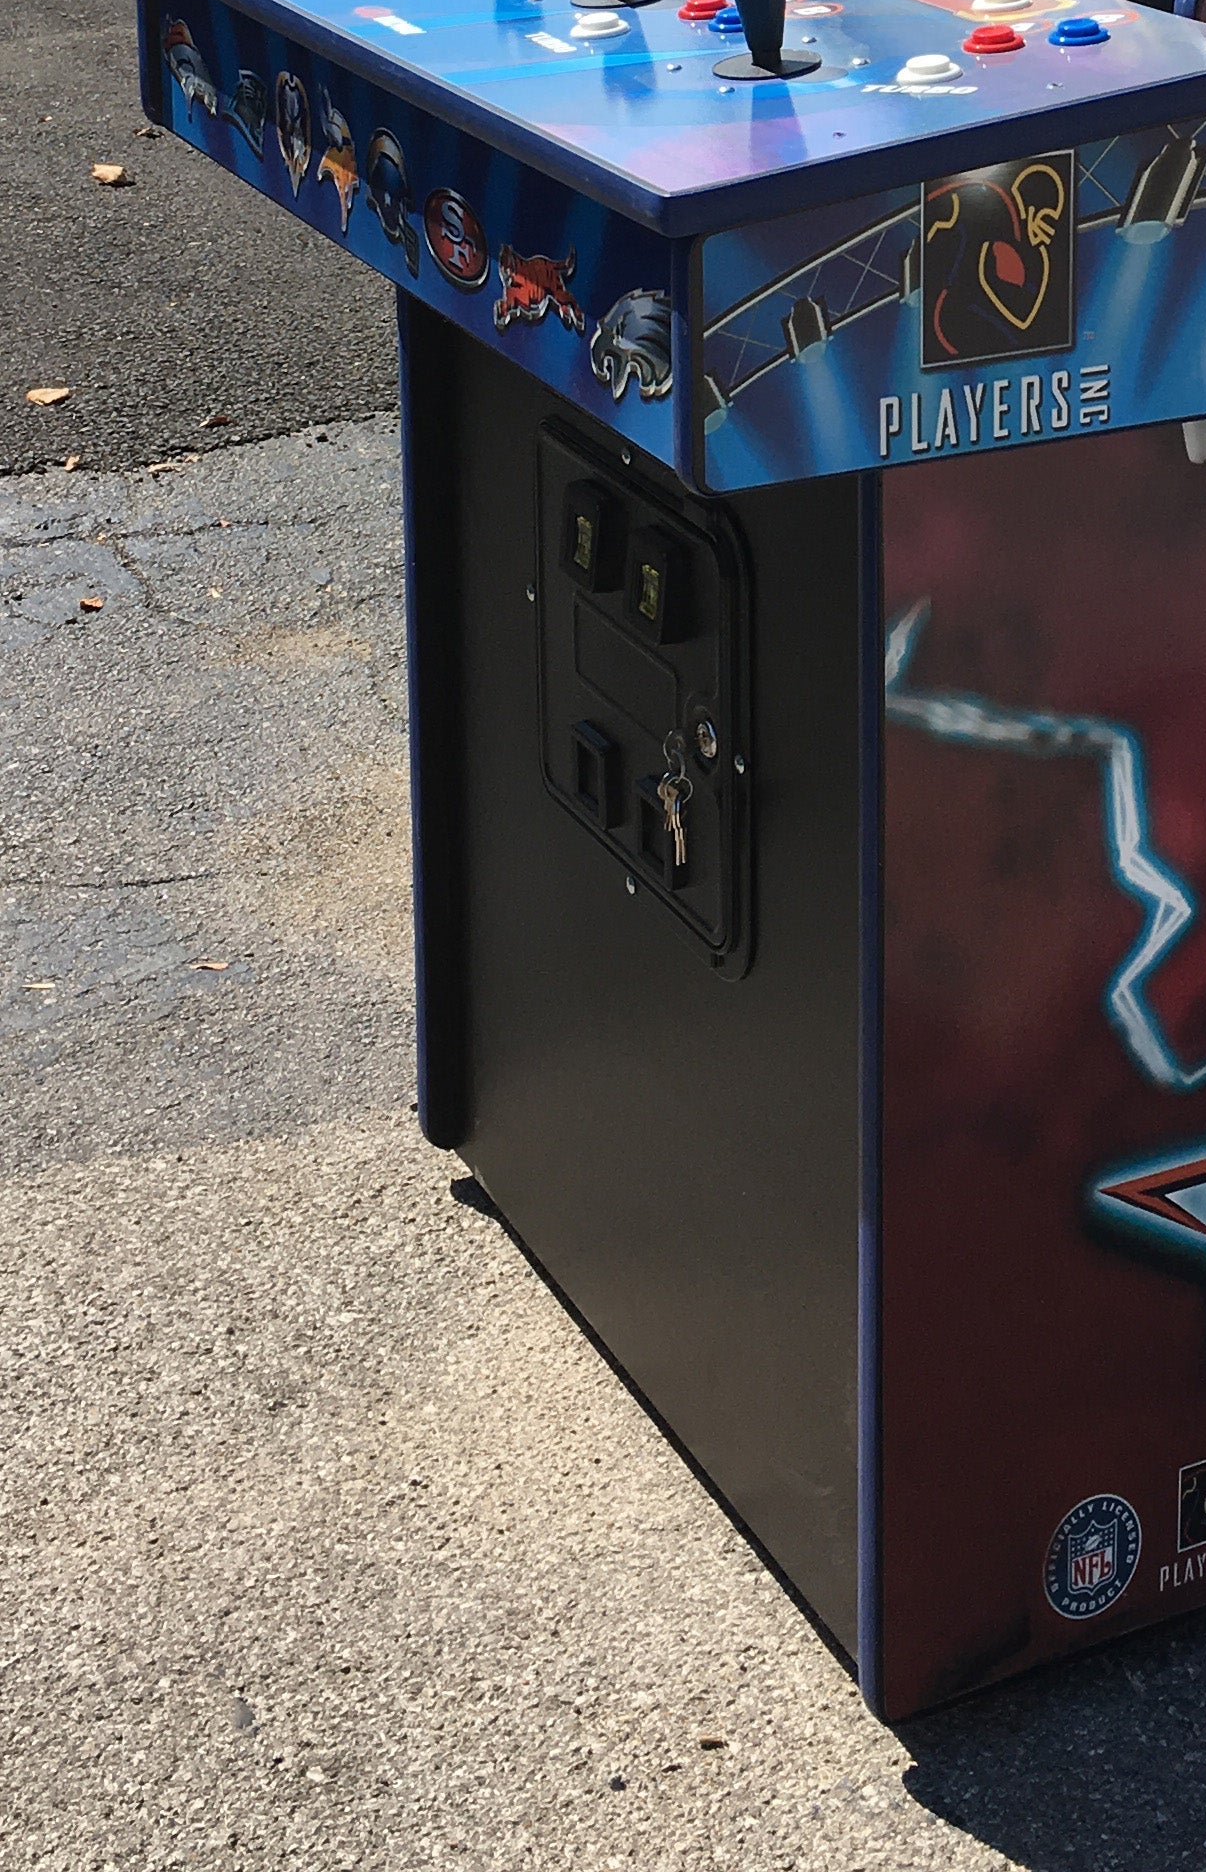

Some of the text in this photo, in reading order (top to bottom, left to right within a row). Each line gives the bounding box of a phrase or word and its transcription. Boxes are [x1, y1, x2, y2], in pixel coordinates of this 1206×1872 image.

[861, 84, 978, 95] TURBO
[879, 364, 1110, 458] PLAYERS INC
[1102, 1501, 1137, 1564] LICENSED
[1071, 1549, 1112, 1587] NFL
[1061, 1579, 1121, 1612] PRODUCT
